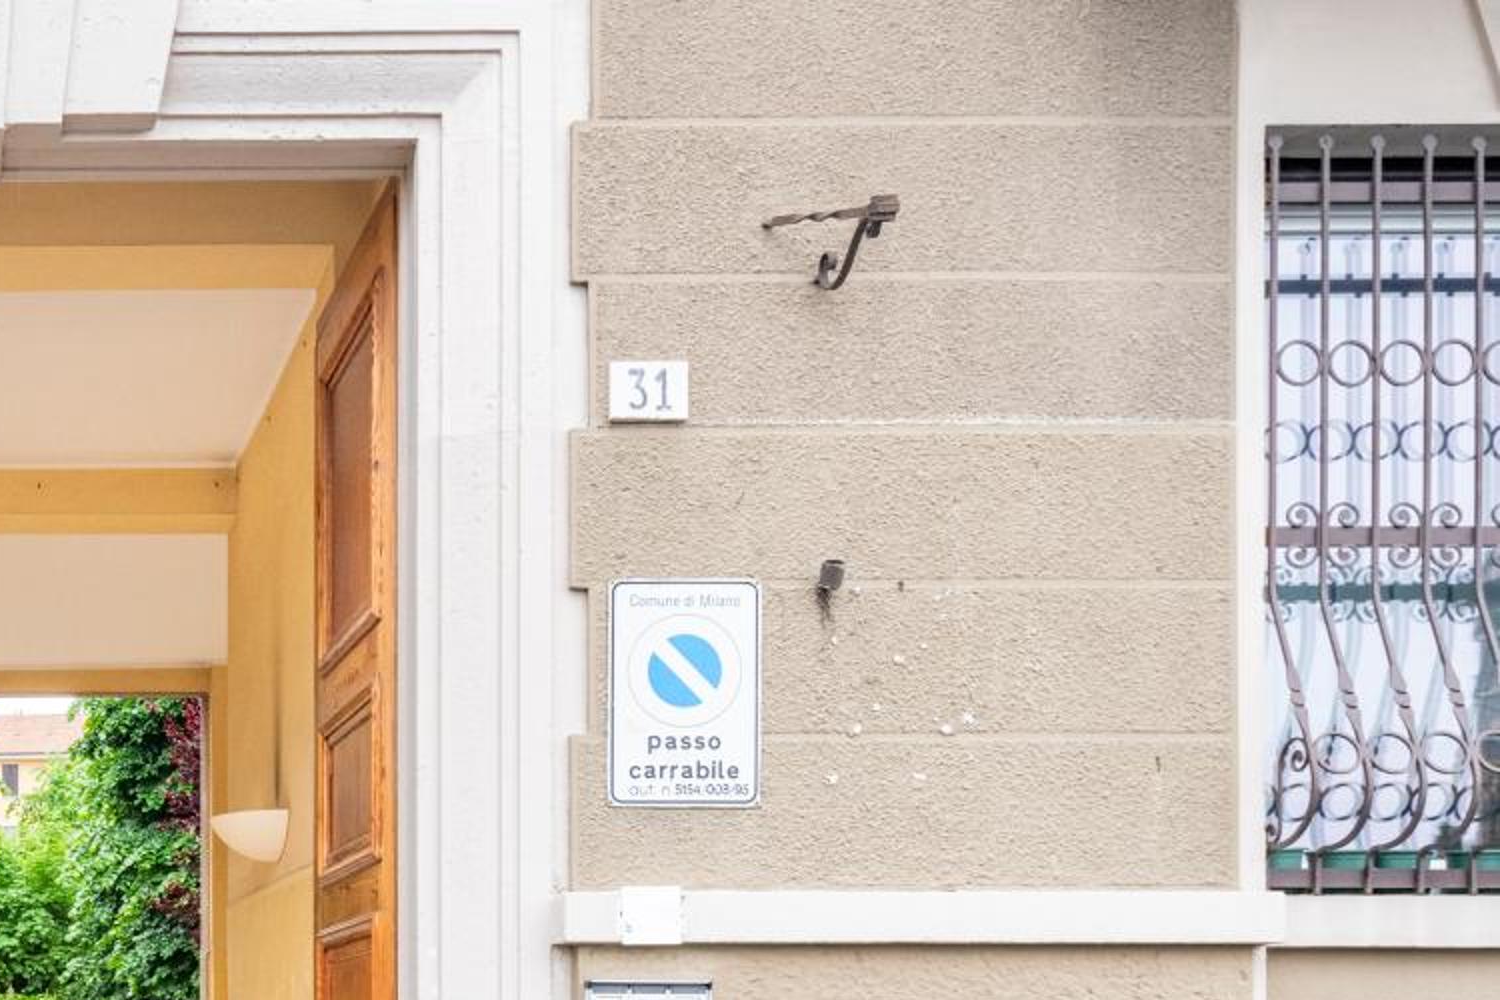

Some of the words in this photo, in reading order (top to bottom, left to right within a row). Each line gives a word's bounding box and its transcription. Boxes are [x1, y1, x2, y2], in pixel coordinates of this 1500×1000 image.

[627, 367, 672, 411] 31
[629, 592, 679, 607] Comune
[683, 592, 695, 607] di
[699, 592, 741, 608] Milano
[647, 735, 722, 755] passo
[629, 759, 740, 779] carrabile
